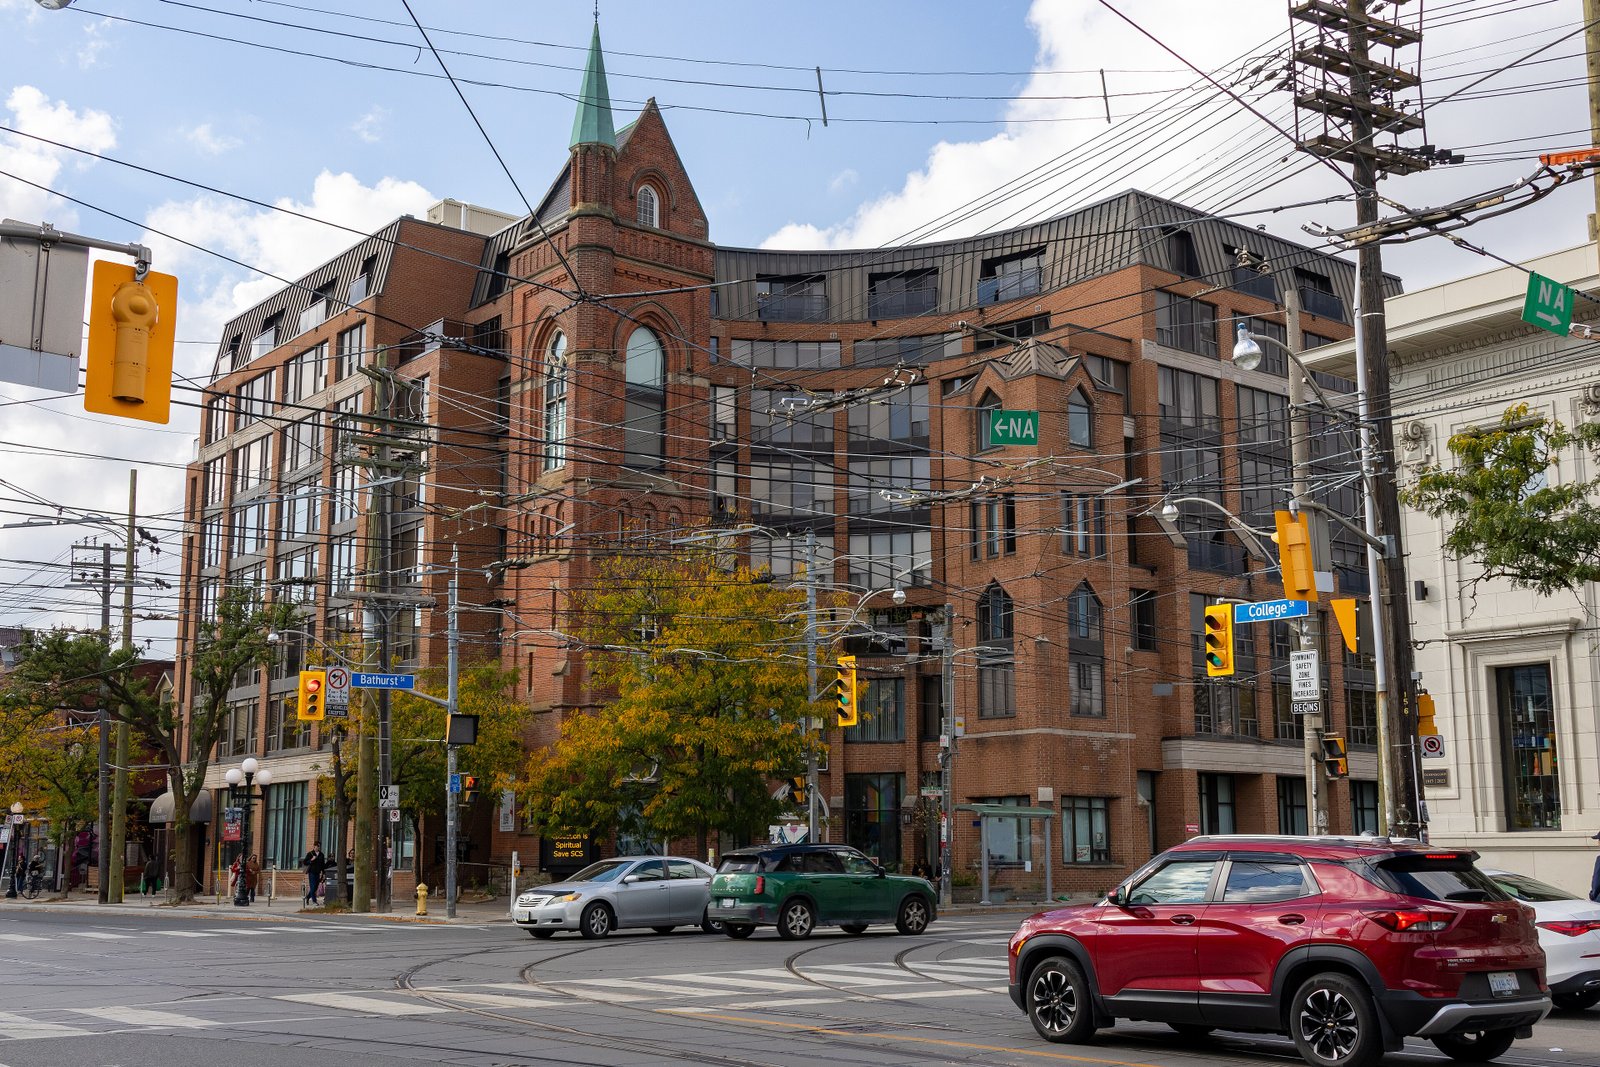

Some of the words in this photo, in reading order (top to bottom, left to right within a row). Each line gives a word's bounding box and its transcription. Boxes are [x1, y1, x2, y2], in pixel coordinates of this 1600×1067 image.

[1538, 281, 1564, 312] NA
[1009, 418, 1034, 438] NA
[1248, 603, 1287, 617] College
[1292, 653, 1315, 661] COMMUNITY
[360, 675, 398, 685] Bathurst
[1294, 704, 1318, 712] BEGINS
[556, 842, 582, 850] Spiritual
